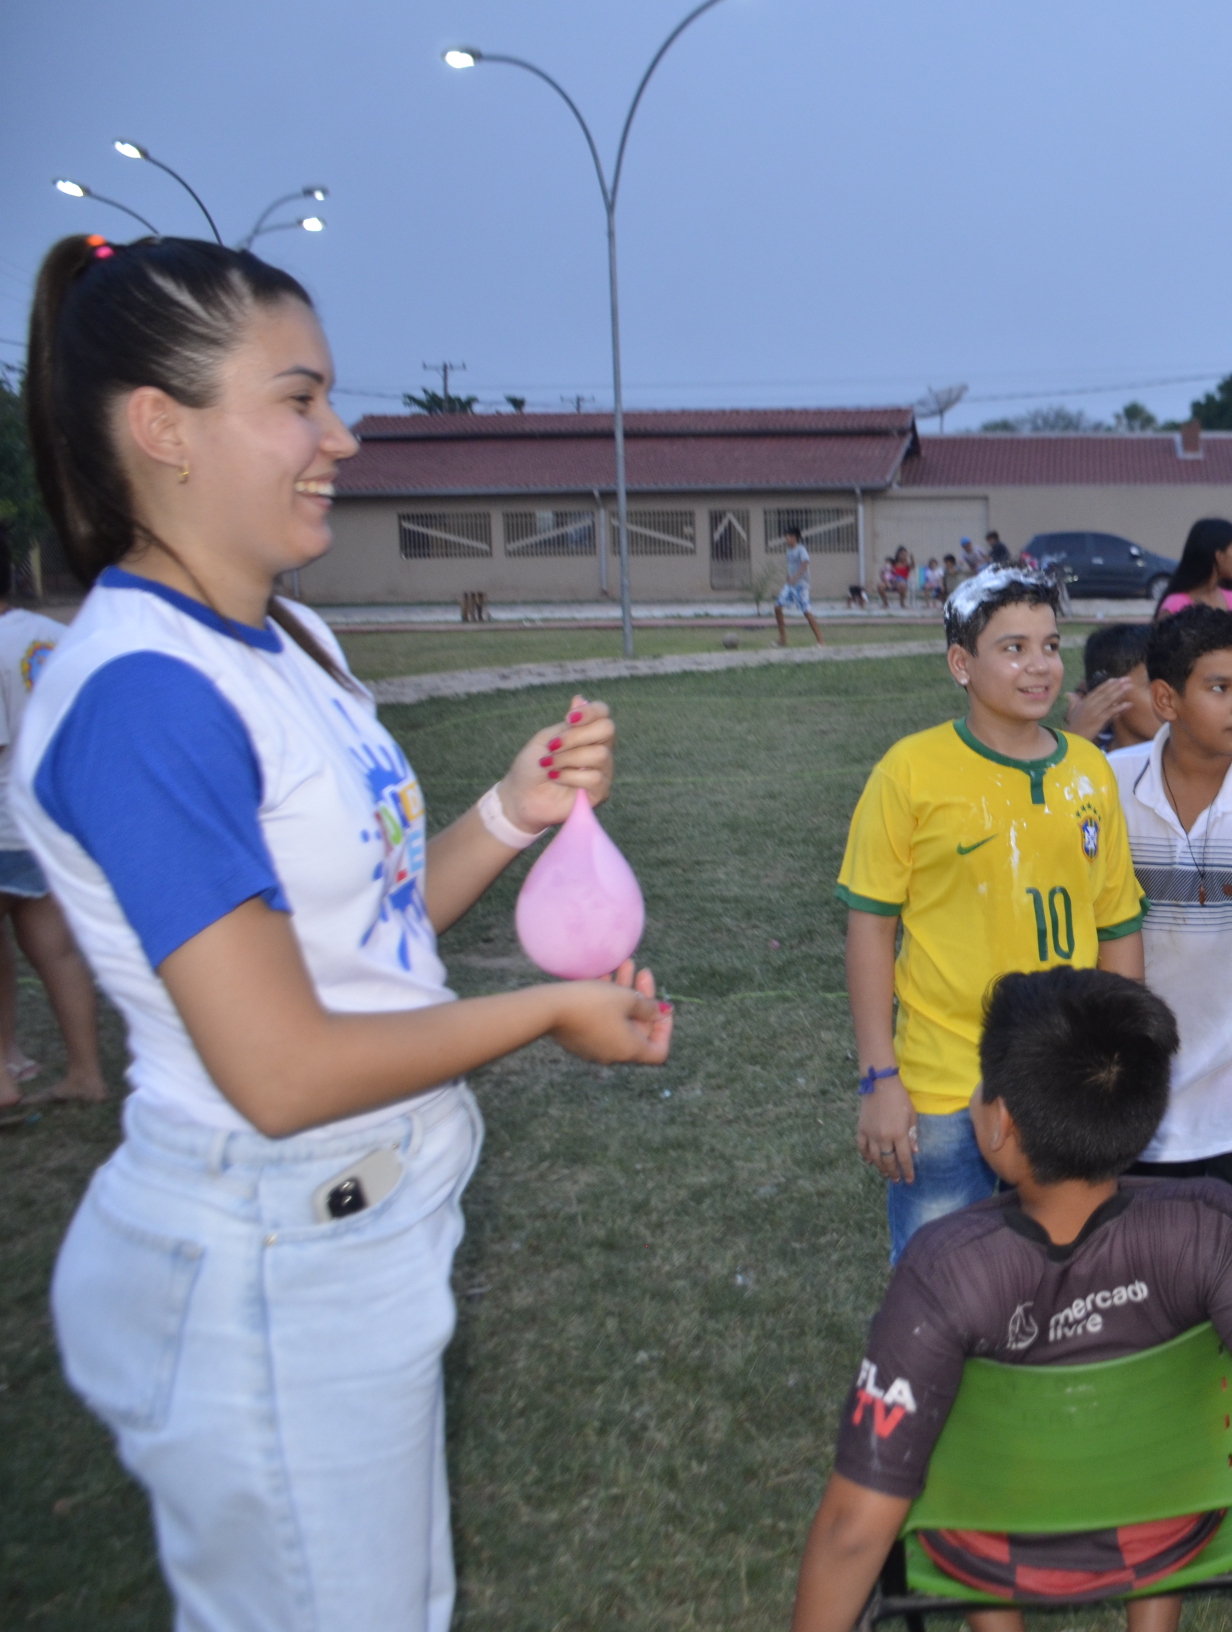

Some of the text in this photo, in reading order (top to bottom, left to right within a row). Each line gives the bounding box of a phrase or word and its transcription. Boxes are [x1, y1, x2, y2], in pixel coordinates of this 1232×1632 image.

[1025, 885, 1076, 962] 10
[1048, 1312, 1103, 1342] livre
[852, 1387, 907, 1439] TV
